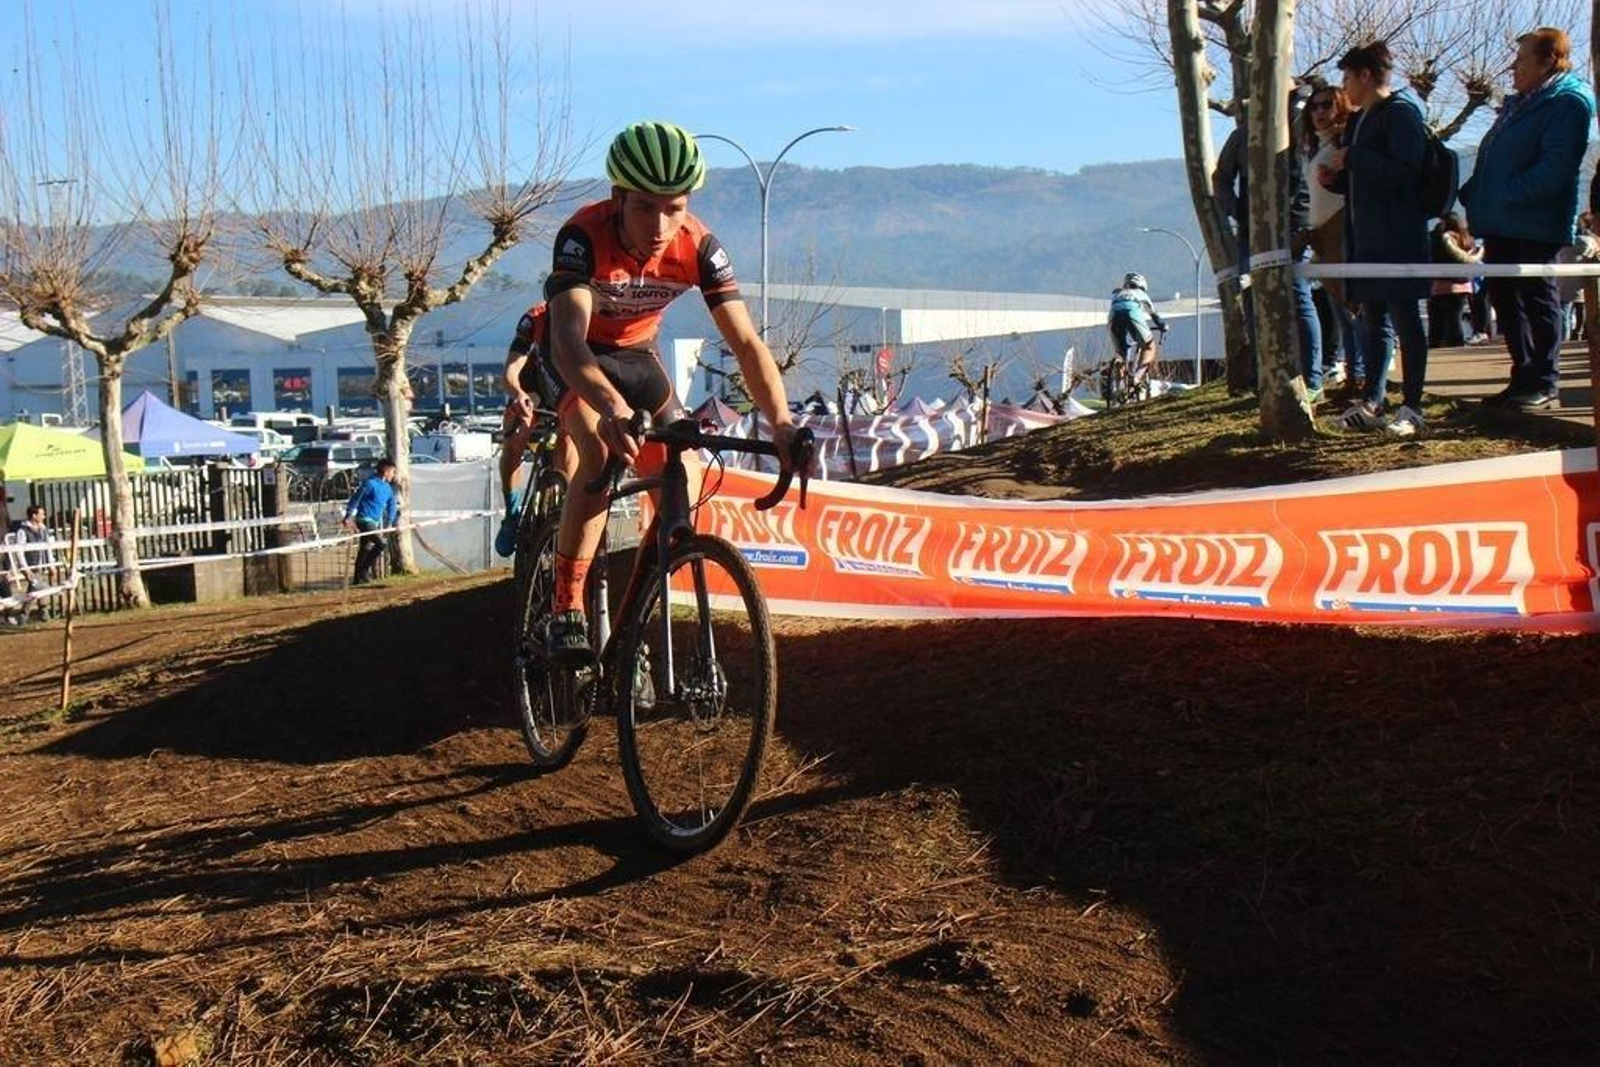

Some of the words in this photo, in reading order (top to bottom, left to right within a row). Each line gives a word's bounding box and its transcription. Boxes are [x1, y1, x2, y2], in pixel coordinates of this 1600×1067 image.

[713, 499, 798, 545] FROIZ
[820, 509, 926, 566] FROIZ
[952, 526, 1077, 577] FROIZ
[1116, 536, 1269, 588] FROIZ
[1324, 529, 1520, 596] FROIZ
